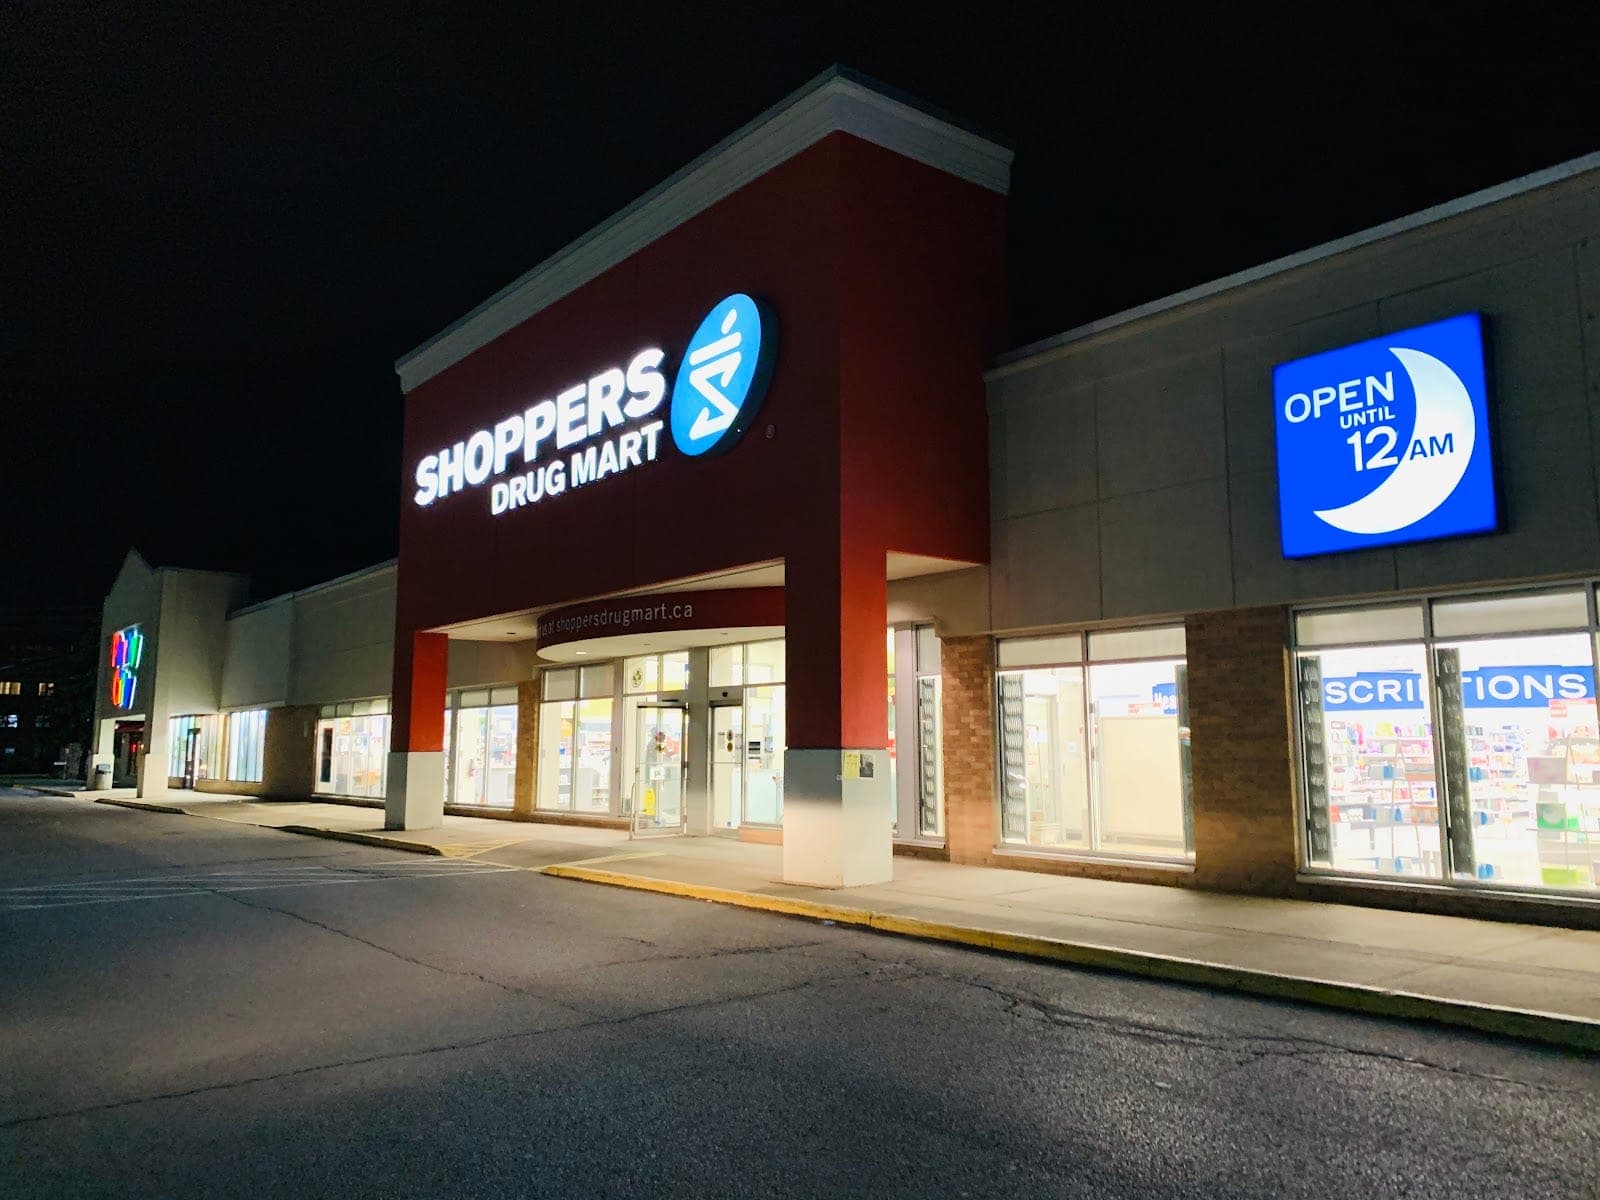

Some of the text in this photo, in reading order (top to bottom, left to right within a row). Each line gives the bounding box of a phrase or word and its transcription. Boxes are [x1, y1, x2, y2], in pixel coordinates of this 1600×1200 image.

[1284, 371, 1395, 424] OPEN
[1340, 406, 1396, 429] UNTIL
[414, 347, 666, 506] SHOPPERS
[1347, 425, 1455, 472] 12 AM
[490, 420, 664, 516] DRUG MART
[556, 602, 693, 632] shoppersdrugmart.ca
